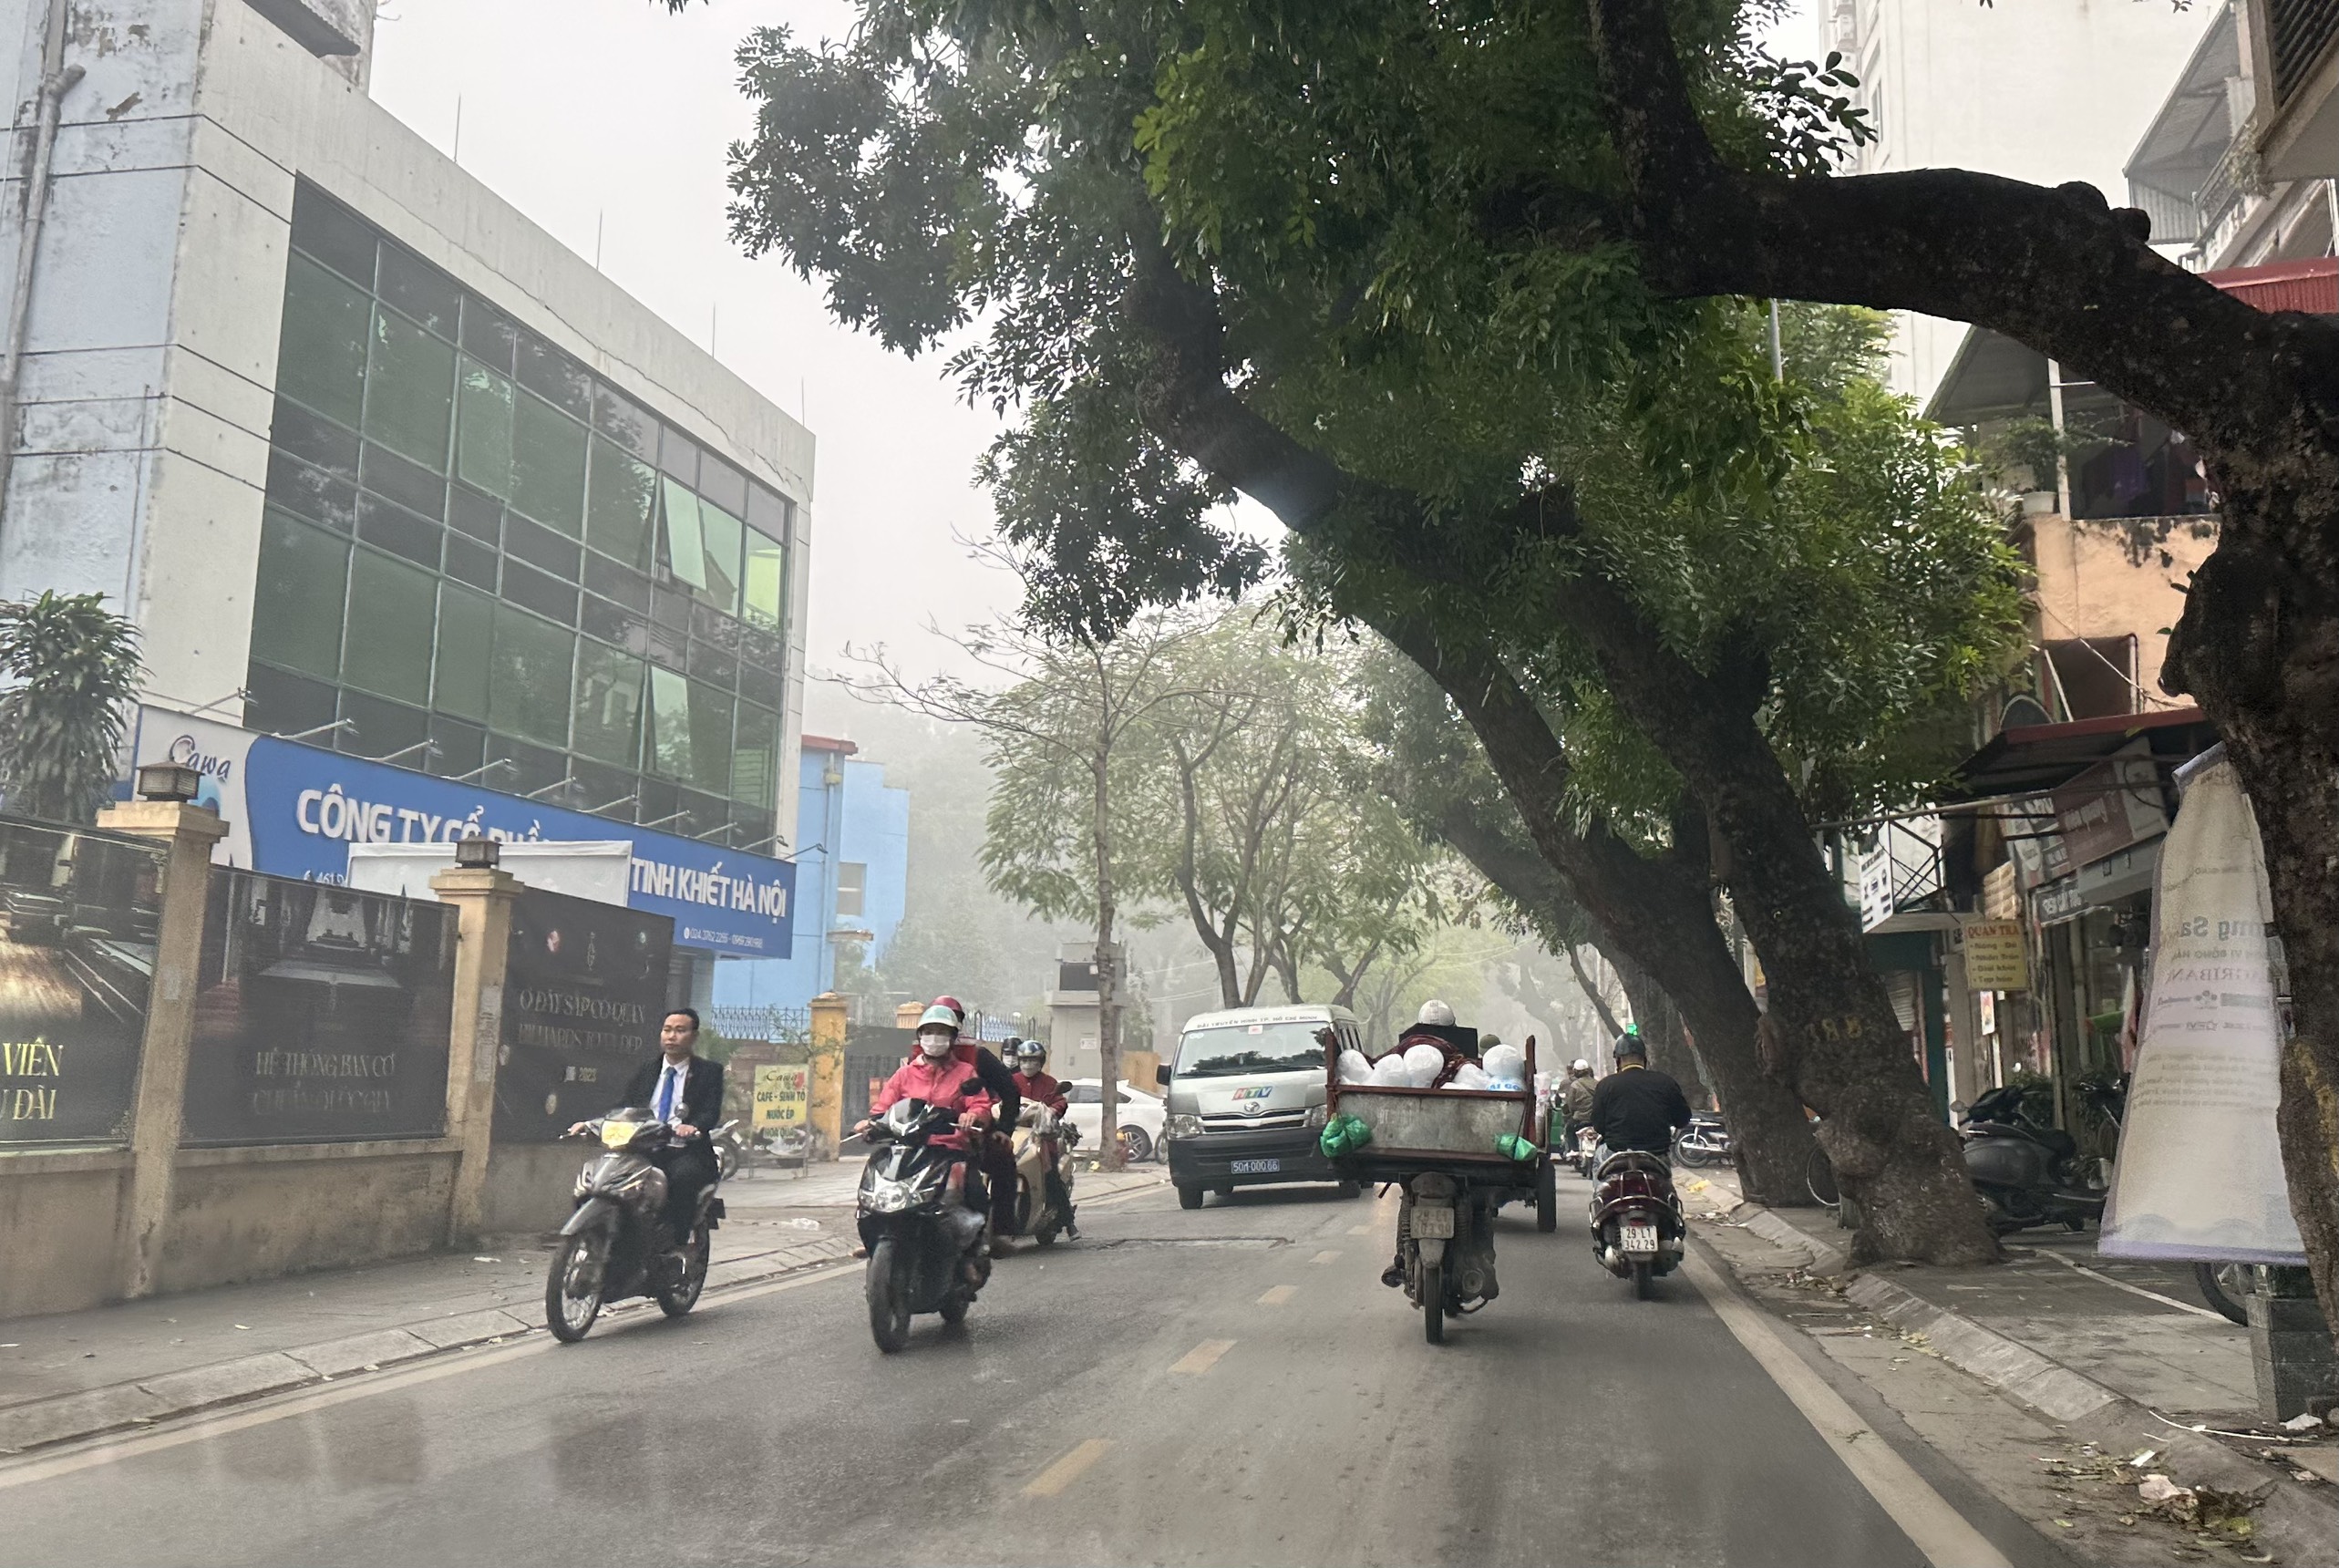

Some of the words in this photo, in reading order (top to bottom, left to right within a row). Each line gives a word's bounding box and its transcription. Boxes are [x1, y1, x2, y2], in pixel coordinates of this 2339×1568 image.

[297, 783, 393, 842] CÔNG
[397, 808, 441, 842] TY
[632, 857, 675, 898] TINH
[676, 861, 730, 907] KHIẾT
[730, 873, 756, 913] HÀ
[757, 879, 787, 924] NỘI
[3, 1037, 64, 1077] VIÊN
[12, 1084, 57, 1120] ĐÀI
[757, 1091, 772, 1102] CAFE
[1233, 1087, 1273, 1099] HTV
